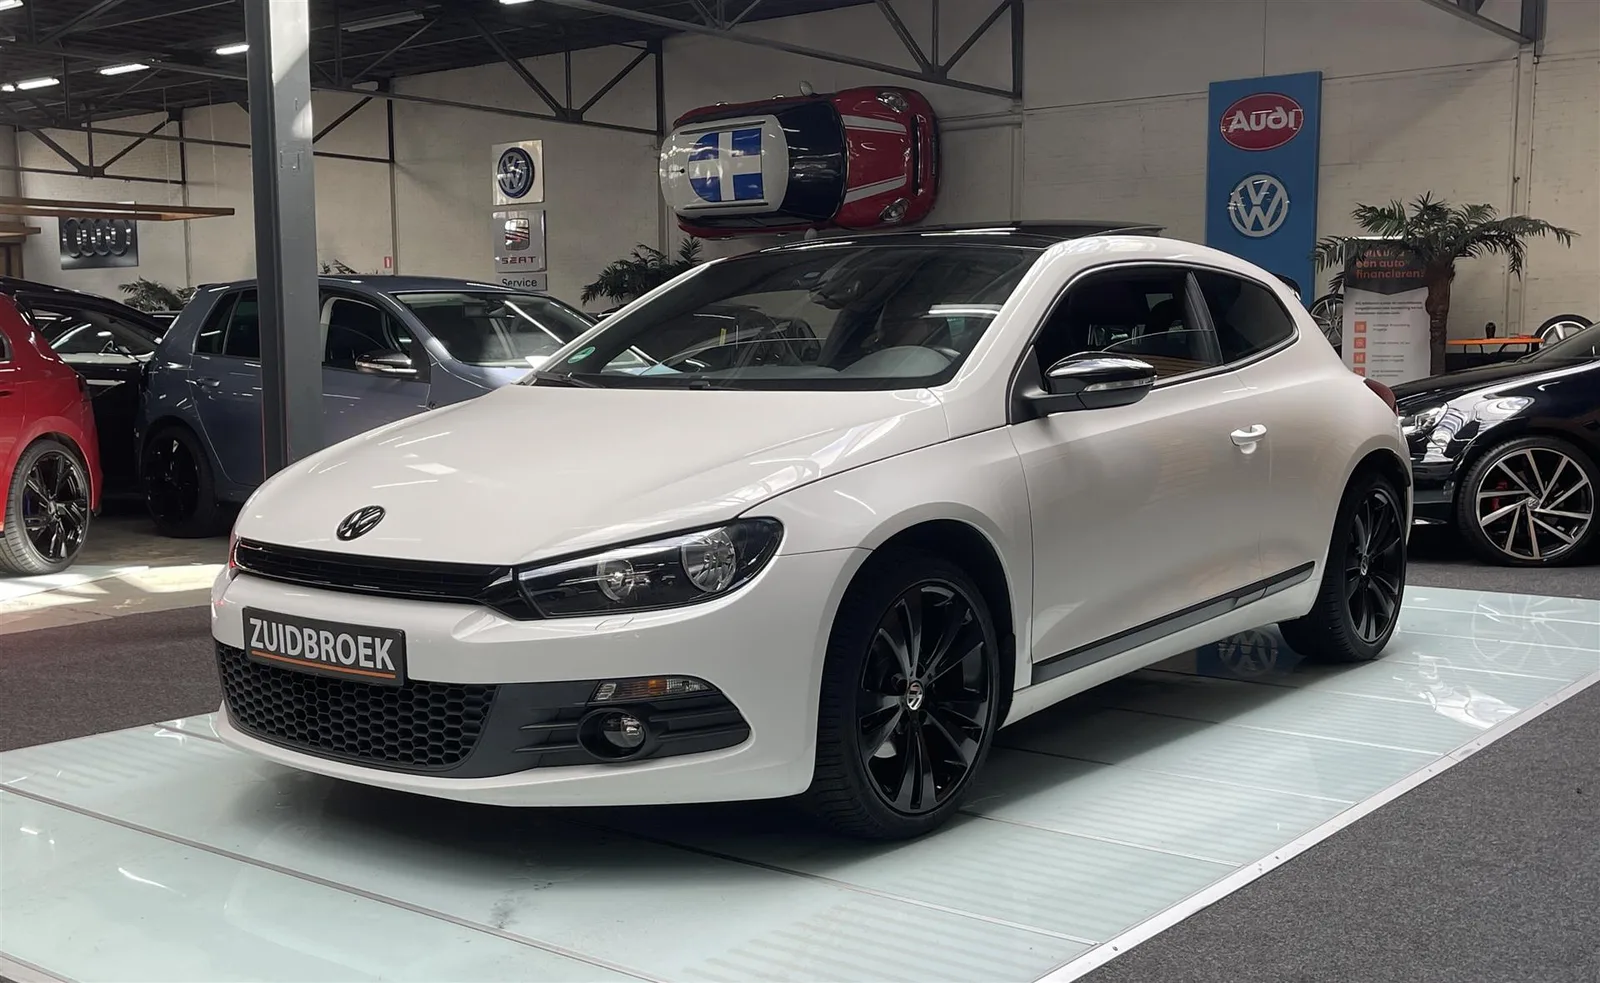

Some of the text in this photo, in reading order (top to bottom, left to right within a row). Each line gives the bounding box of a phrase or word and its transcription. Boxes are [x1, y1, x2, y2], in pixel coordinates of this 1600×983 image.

[1228, 106, 1298, 133] Audi
[501, 256, 536, 265] SEAT
[1379, 259, 1406, 268] auto
[501, 277, 538, 288] Service
[249, 617, 396, 671] ZUIDBROEK
